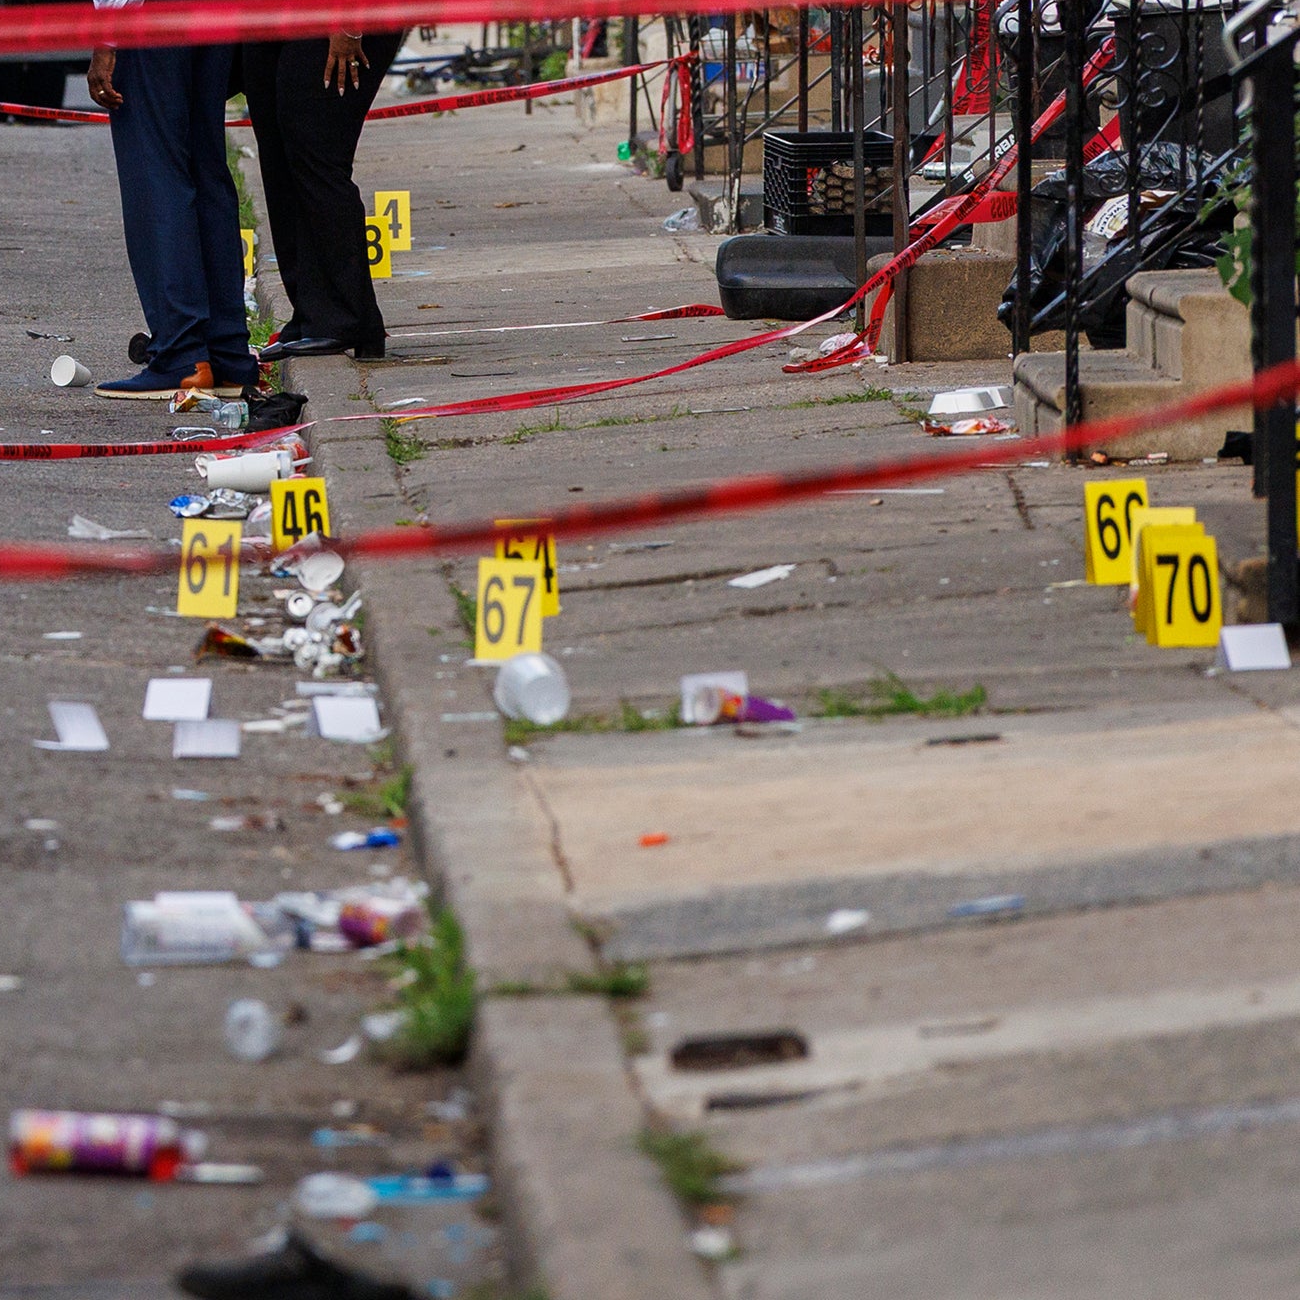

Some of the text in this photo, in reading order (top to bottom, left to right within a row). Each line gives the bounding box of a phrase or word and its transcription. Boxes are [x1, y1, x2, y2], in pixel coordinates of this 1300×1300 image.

[383, 199, 402, 239] 4
[282, 489, 323, 544] 46
[186, 534, 235, 596] 61
[1156, 553, 1213, 624] 70
[483, 576, 535, 645] 67
